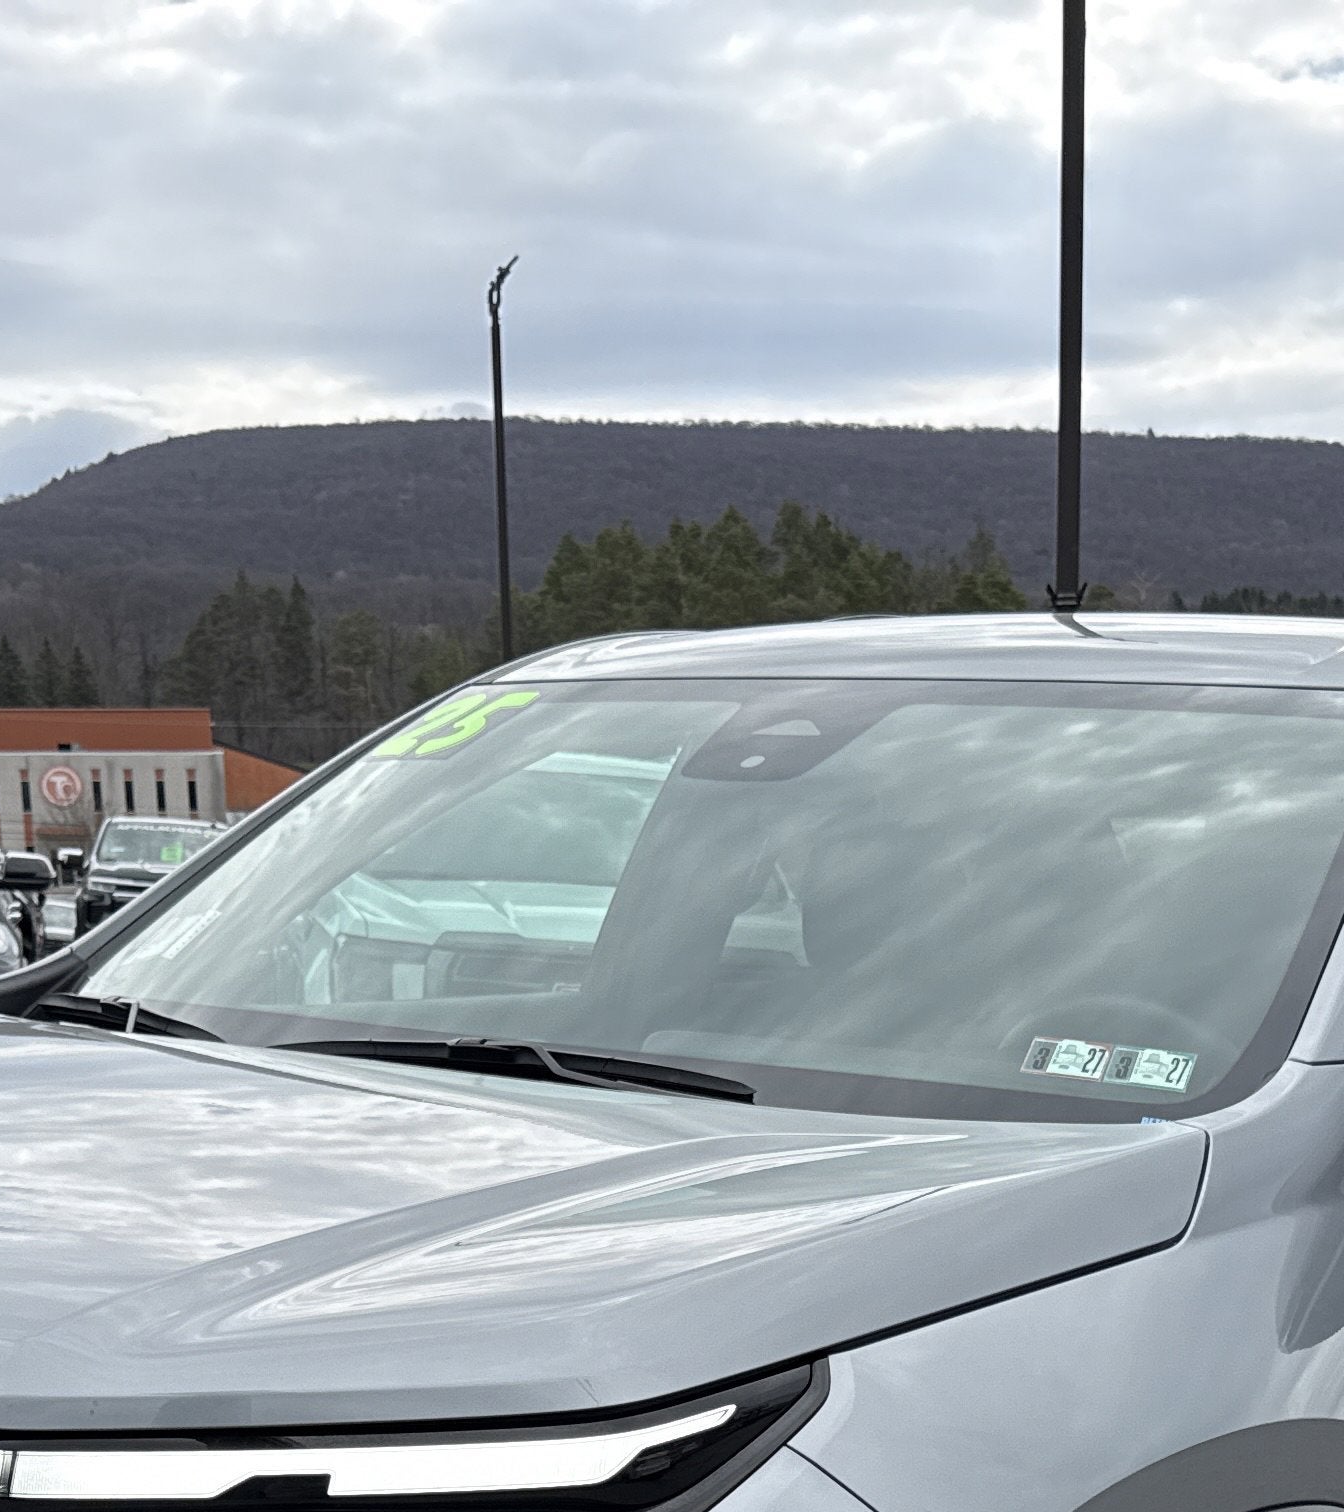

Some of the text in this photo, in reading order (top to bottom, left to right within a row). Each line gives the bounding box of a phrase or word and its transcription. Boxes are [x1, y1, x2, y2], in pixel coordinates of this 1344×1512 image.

[372, 691, 540, 757] 25
[1033, 1047, 1107, 1076] 3 27
[1115, 1056, 1190, 1085] 3 27
